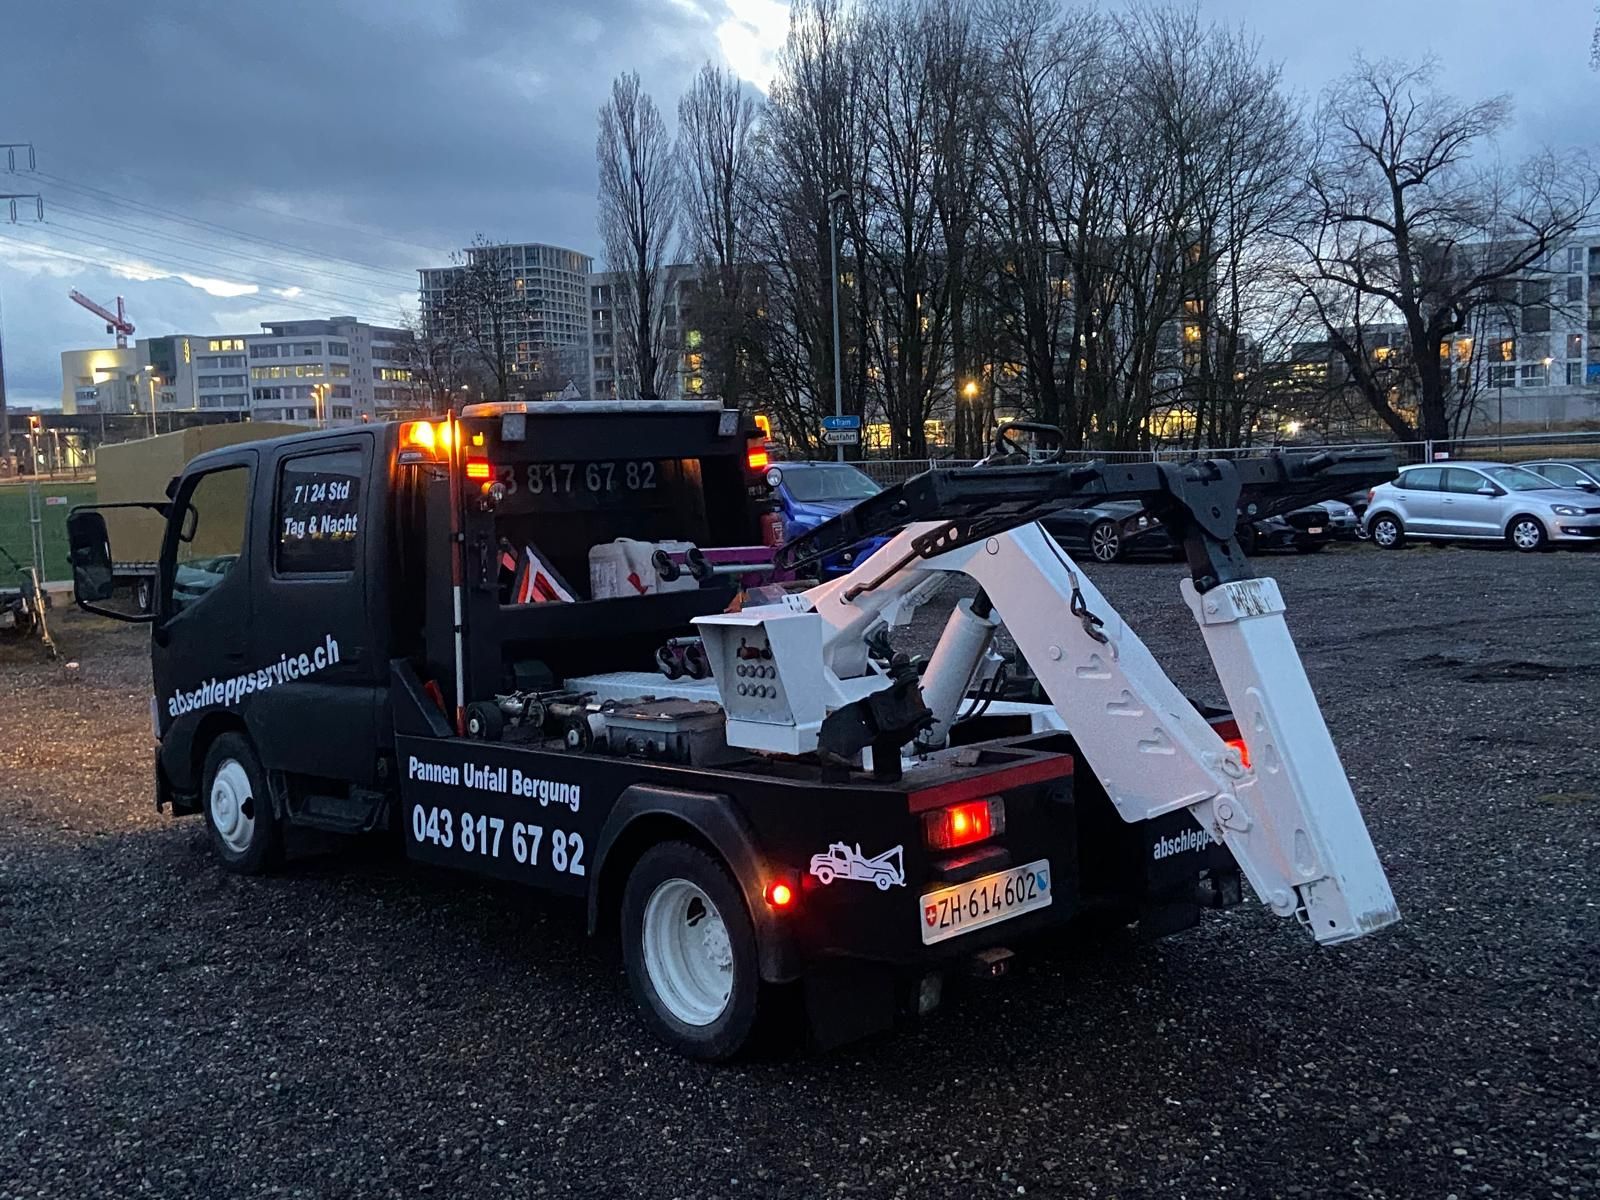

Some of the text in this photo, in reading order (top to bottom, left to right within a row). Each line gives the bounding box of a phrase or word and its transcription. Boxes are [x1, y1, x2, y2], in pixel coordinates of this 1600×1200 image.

[827, 432, 856, 441] Ausfahrt
[294, 485, 303, 504] 7
[310, 482, 326, 502] 24
[328, 480, 351, 500] Std
[527, 464, 576, 494] 817
[586, 462, 615, 492] 67
[626, 461, 657, 490] 82
[284, 513, 358, 540] Tag & Nacht
[168, 633, 341, 717] abschleppservice.ch
[408, 756, 581, 813] Pannen Unfall Bergung
[412, 803, 586, 877] 043 817 67 82
